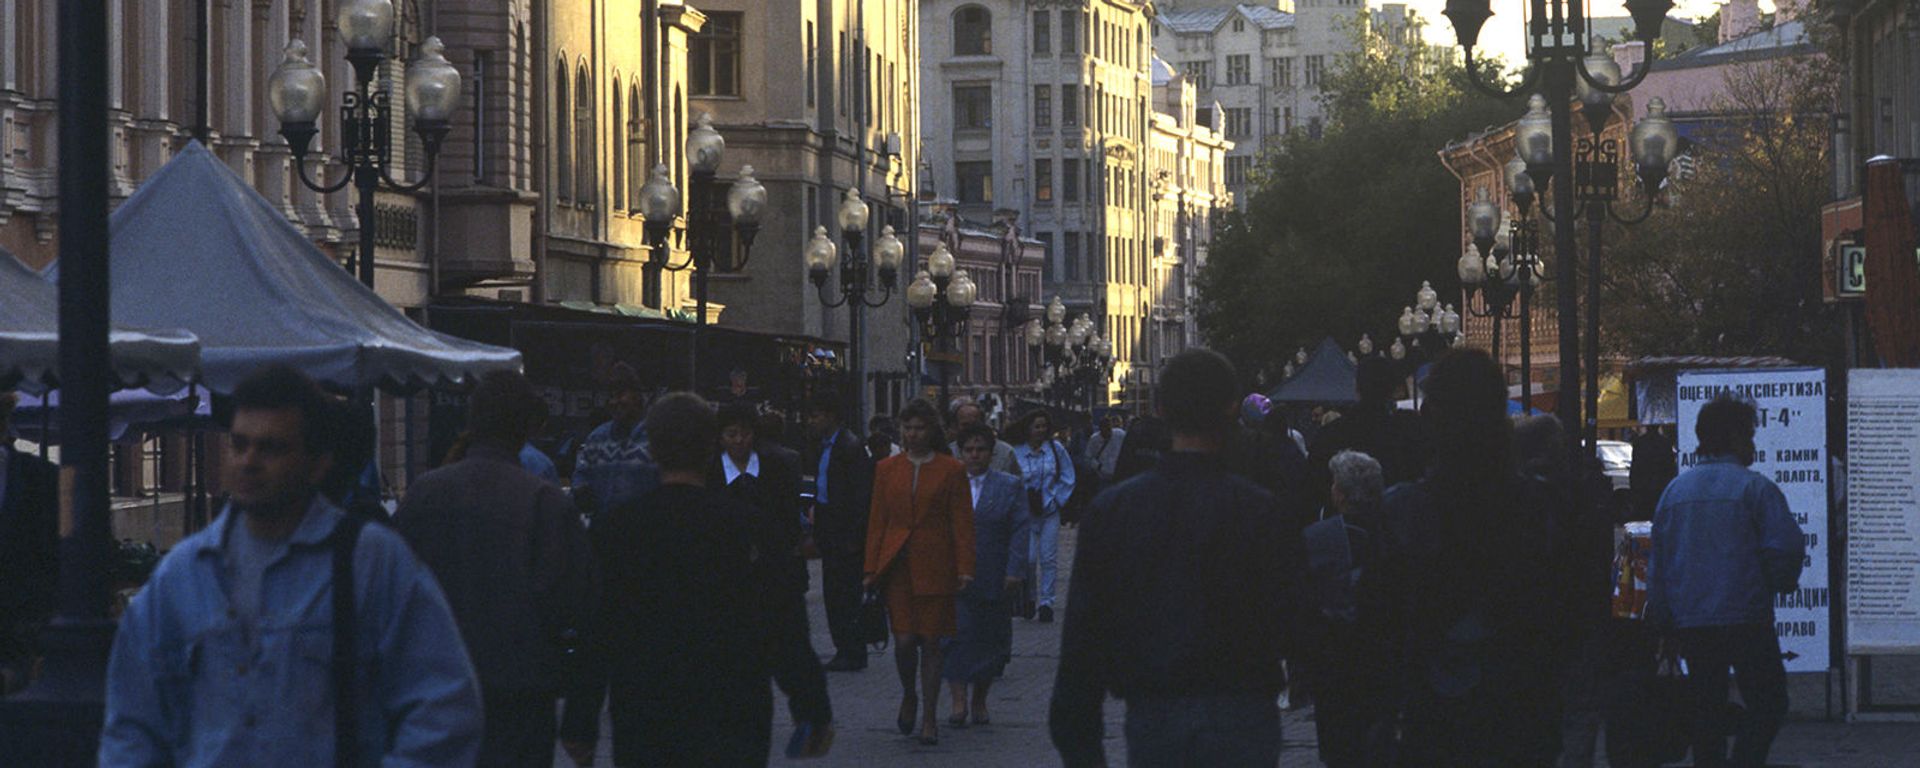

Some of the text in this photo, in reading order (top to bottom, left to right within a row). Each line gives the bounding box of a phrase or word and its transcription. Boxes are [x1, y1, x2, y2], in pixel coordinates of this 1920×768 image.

[1776, 449, 1819, 462] камни
[1775, 469, 1824, 484] золота,
[1777, 620, 1816, 637] ПРАВО
